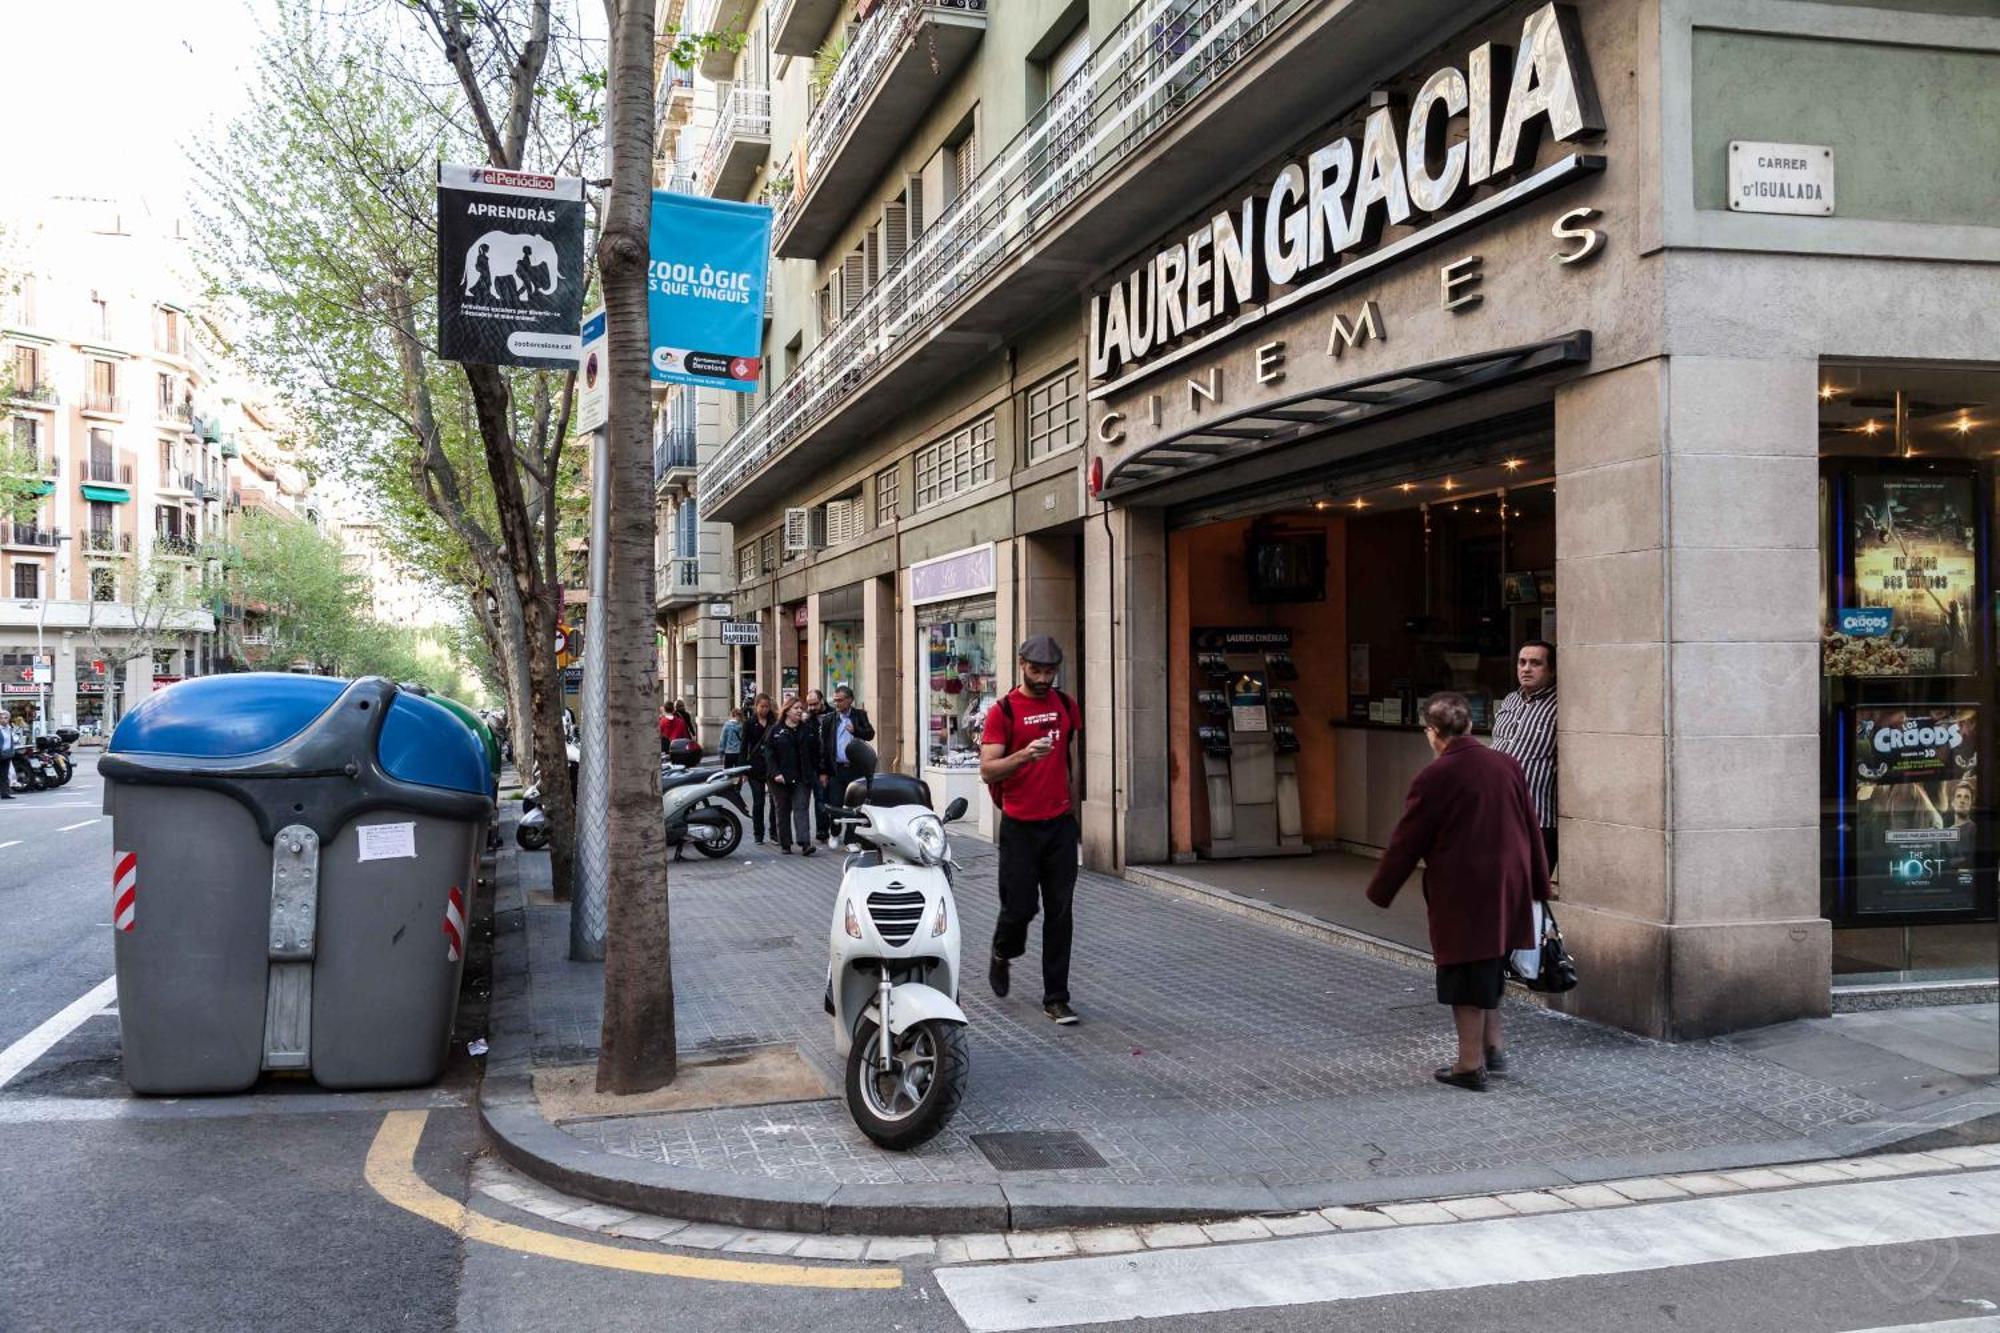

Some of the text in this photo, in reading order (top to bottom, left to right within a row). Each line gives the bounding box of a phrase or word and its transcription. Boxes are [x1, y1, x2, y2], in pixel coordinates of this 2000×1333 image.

[1758, 156, 1808, 171] CARRER
[497, 171, 554, 190] Periódico
[467, 202, 556, 223] APRENDRÀS
[648, 260, 751, 291] ZOOLÒGIC
[661, 281, 689, 297] QUE
[693, 285, 750, 304] VINGUIS
[1088, 195, 1254, 381] LAUREN
[1098, 206, 1604, 444] CINEMES
[1226, 633, 1254, 643] LAUREN
[1874, 724, 1963, 752] CROODS
[1909, 851, 1924, 860] THE
[1888, 859, 1946, 880] HOST
